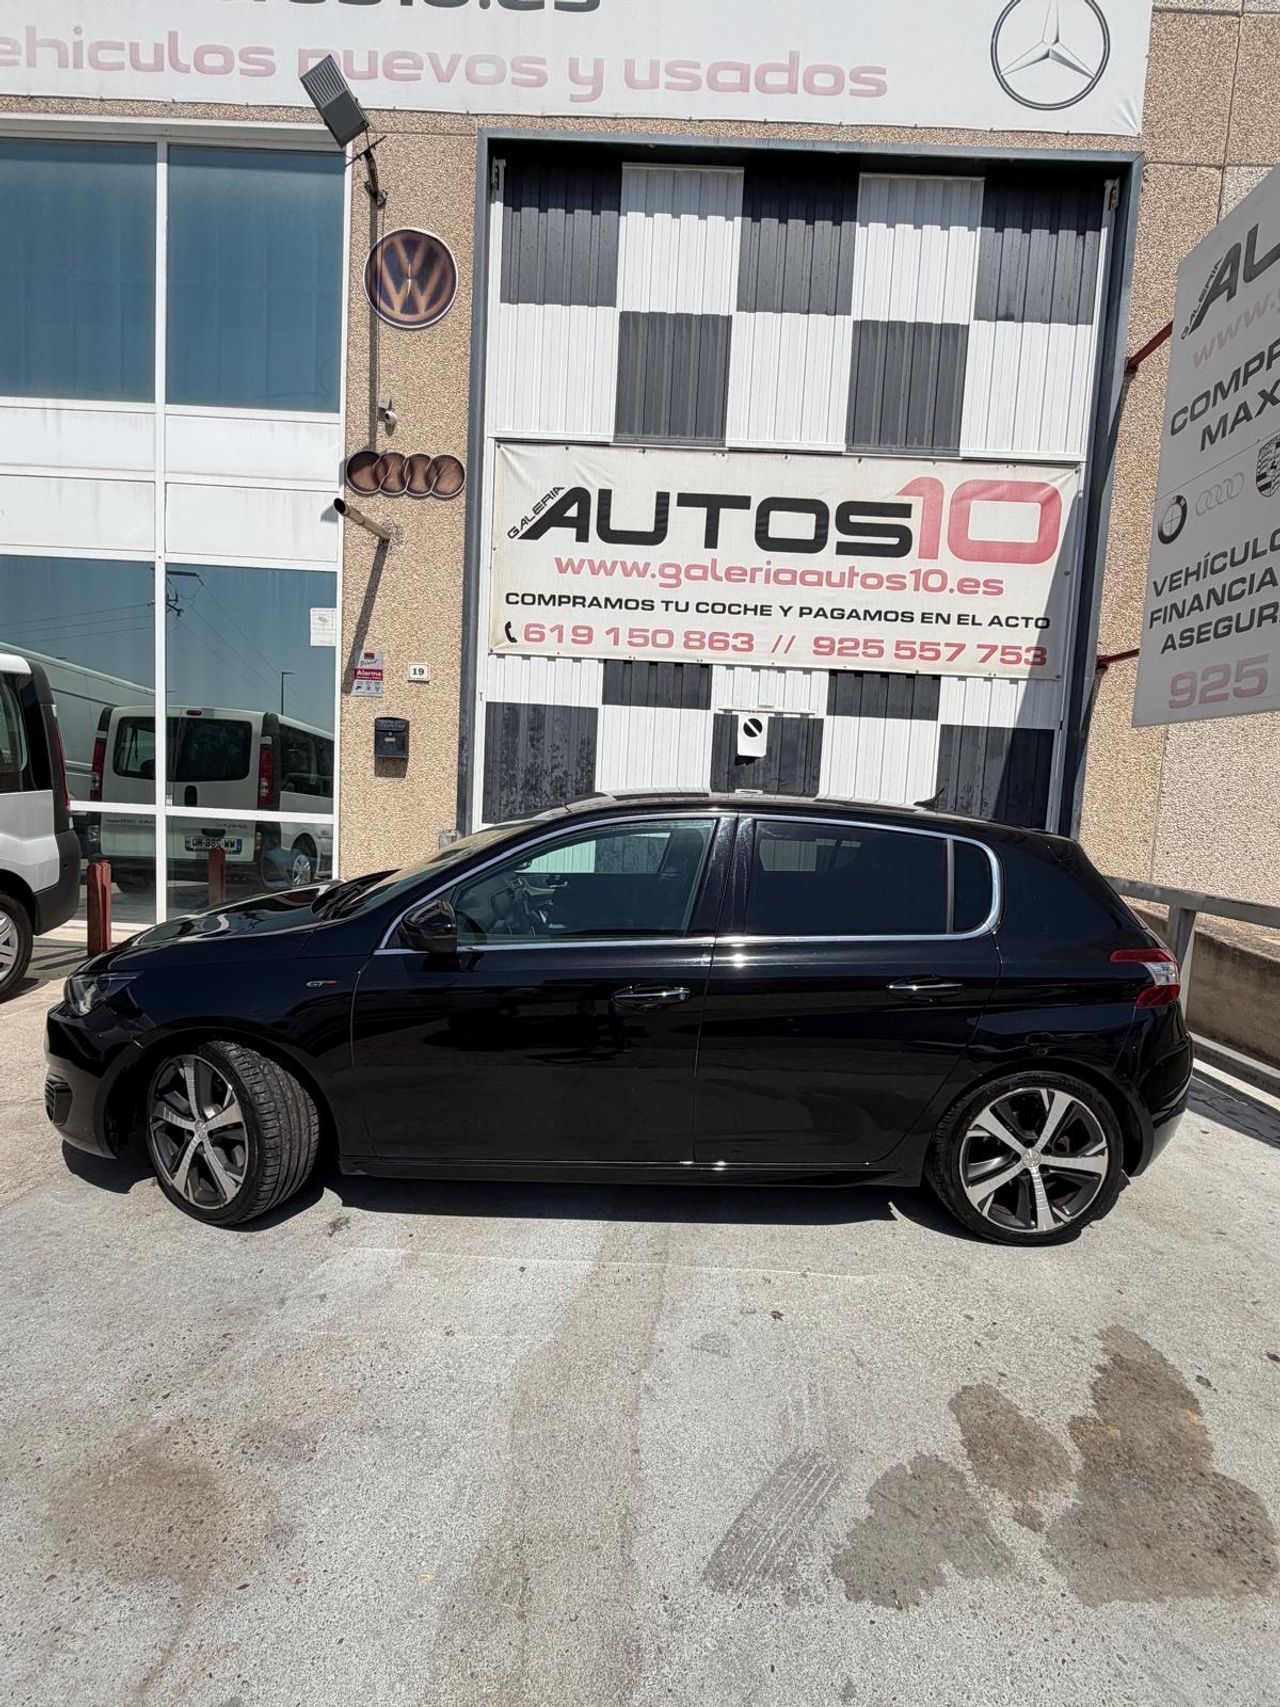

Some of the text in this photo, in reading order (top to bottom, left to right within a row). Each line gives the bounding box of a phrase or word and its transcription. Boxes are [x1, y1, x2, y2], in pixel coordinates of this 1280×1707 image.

[568, 58, 604, 102] y
[623, 50, 887, 98] usados
[1193, 284, 1280, 369] www.
[506, 486, 565, 540] GALERIA
[518, 476, 1062, 564] AUTOS10
[554, 556, 1004, 597] www.galeriaautos10.es
[1149, 566, 1278, 629] FINANCIA
[505, 592, 1050, 630] COMPRAMOS TU COCHE Y PAGAMOS EN EL ACTO
[1161, 600, 1280, 654] ASEGUR
[412, 667, 425, 676] 19
[523, 622, 594, 644] 619
[605, 627, 675, 648] 150
[683, 631, 755, 653] 863
[812, 636, 885, 659] 925
[893, 640, 966, 663] 557
[975, 644, 1048, 667] 753
[1168, 653, 1270, 710] 925
